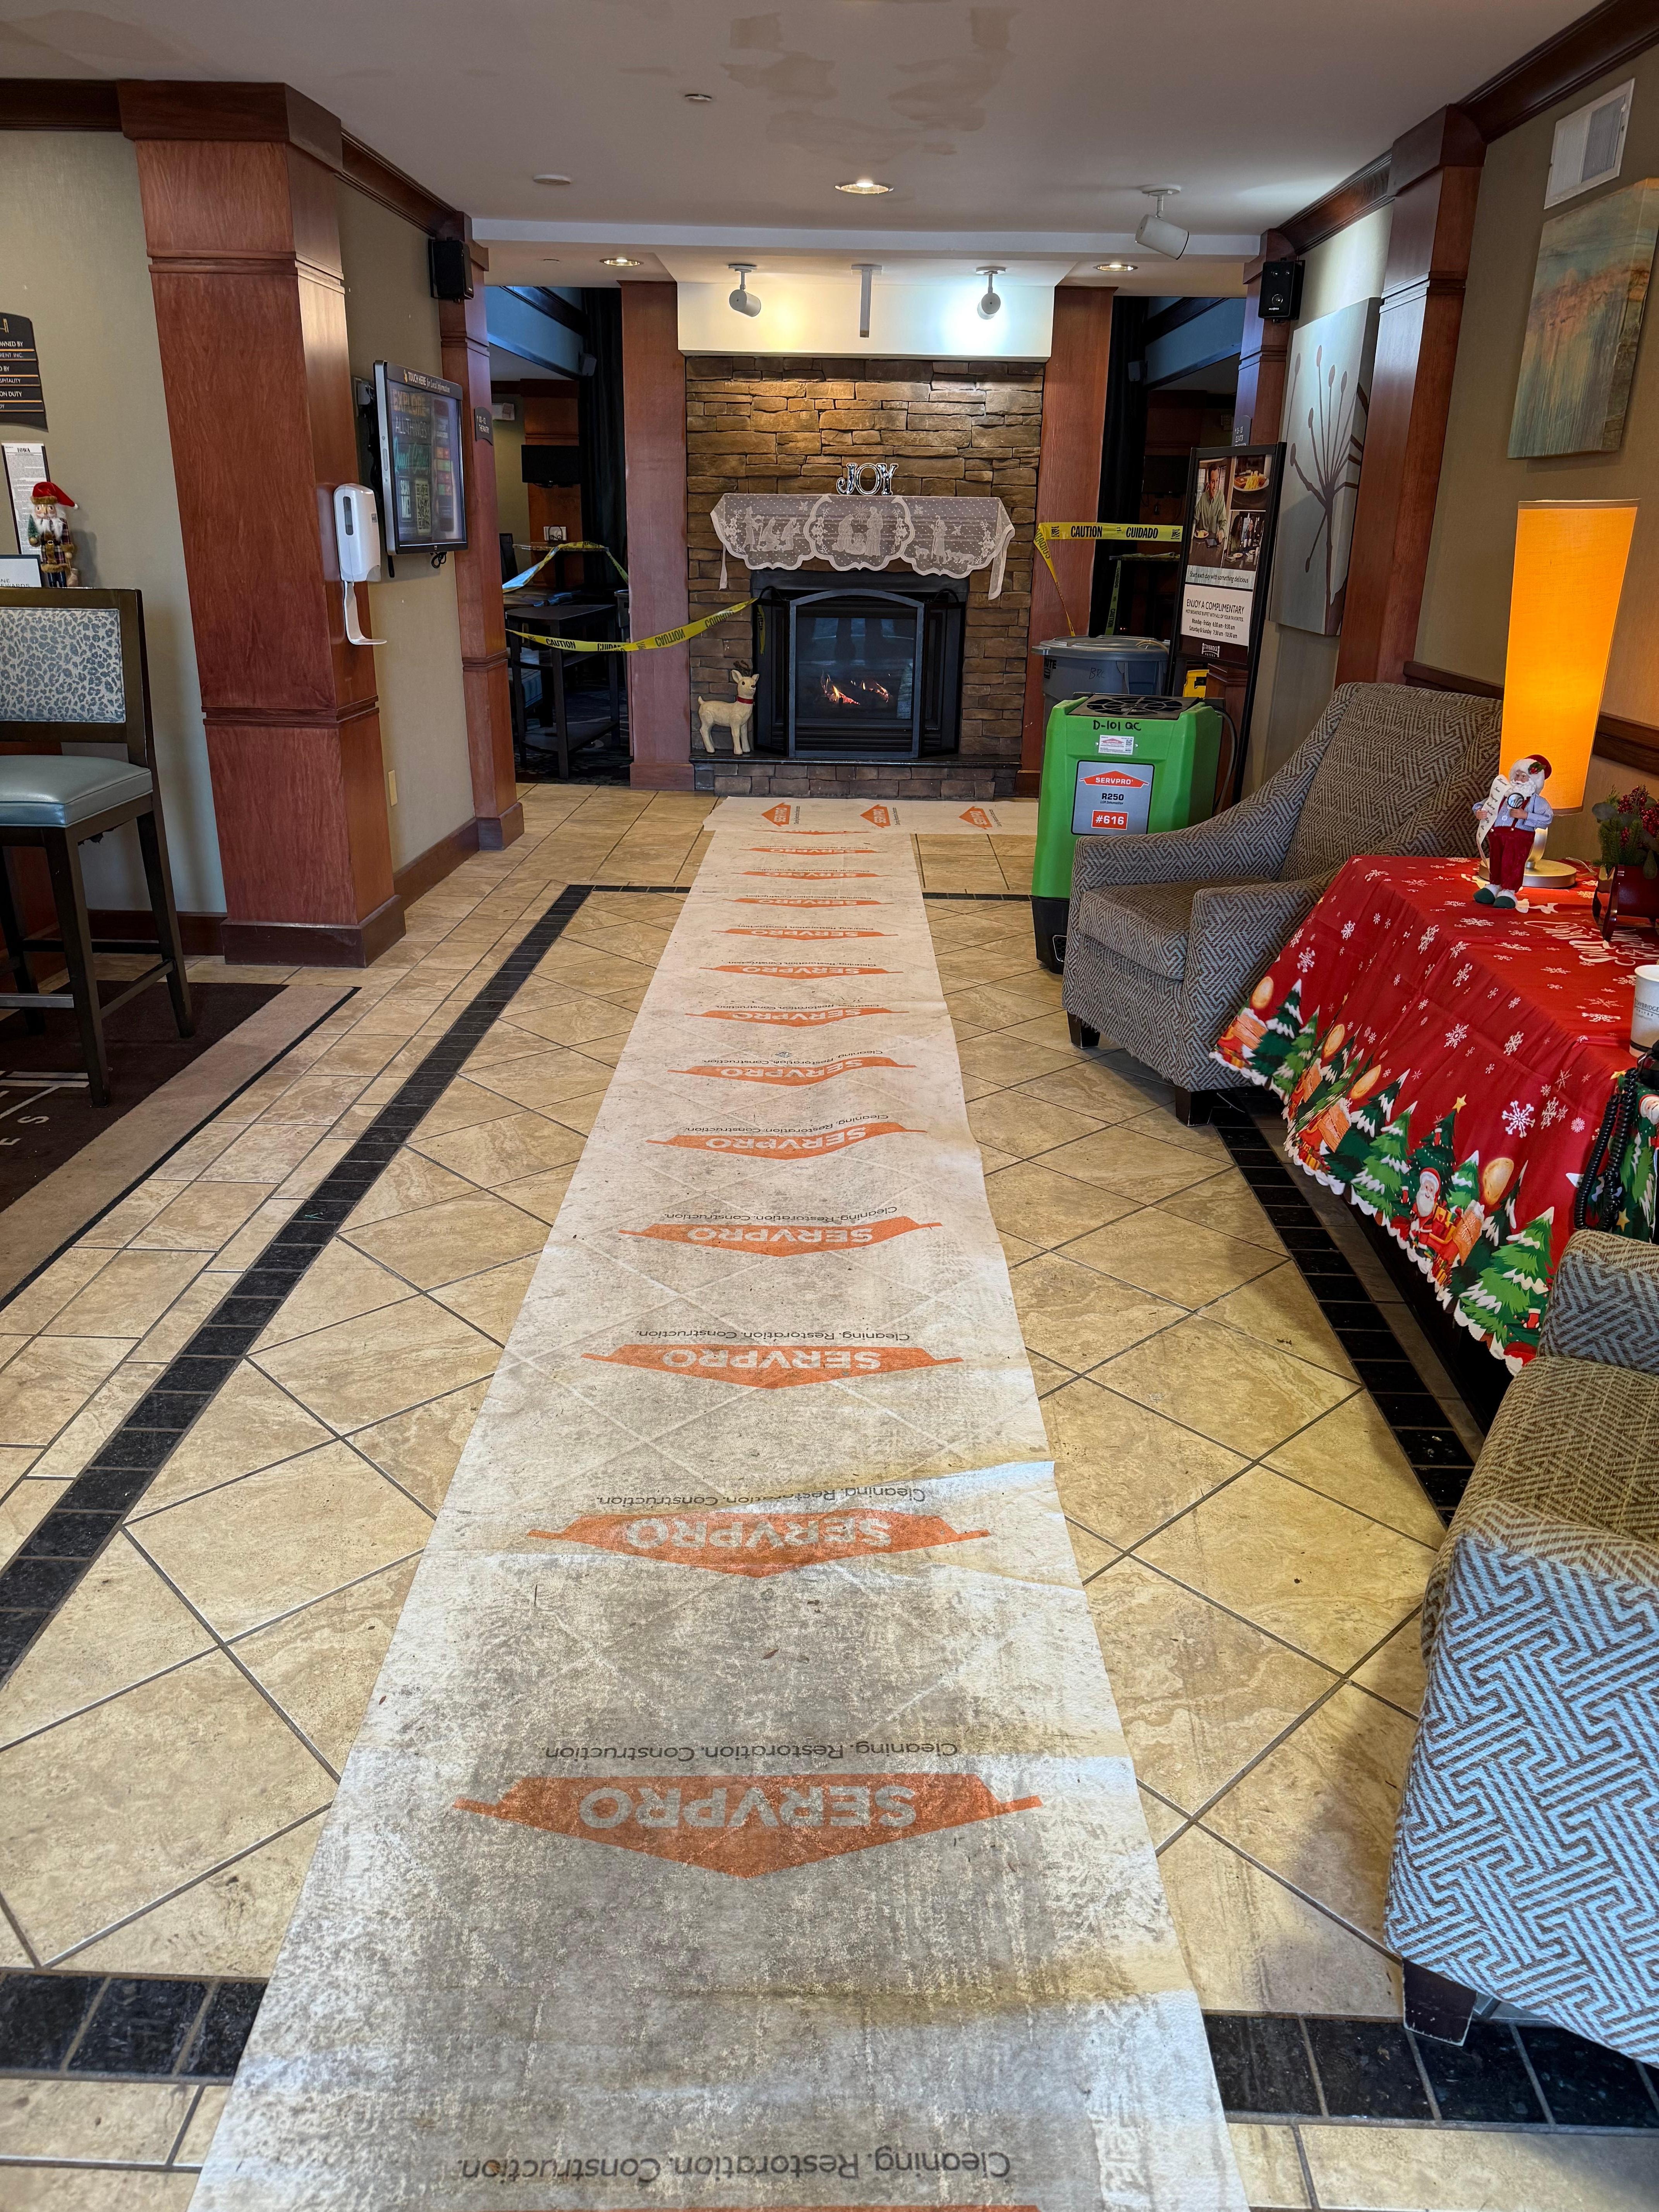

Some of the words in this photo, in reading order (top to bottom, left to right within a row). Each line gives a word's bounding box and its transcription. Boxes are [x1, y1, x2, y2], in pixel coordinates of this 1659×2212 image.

[408, 371, 419, 383] TOUCH
[395, 416, 406, 434] ALL
[836, 462, 899, 496] JOY
[1070, 526, 1103, 538] CAUTION
[1126, 527, 1158, 539] CUIDADO
[1218, 575, 1234, 583] something
[1187, 599, 1201, 608] ENJOY
[1206, 601, 1245, 615] COMPLIMENTARY
[546, 638, 576, 649] CAUTION
[1089, 668, 1105, 679] BRC
[1093, 720, 1120, 731] D-101
[1125, 721, 1142, 731] QC
[1096, 815, 1124, 825] #616
[732, 1009, 862, 1020] SERVPRO
[721, 1060, 862, 1077] SERVPRO
[706, 1127, 866, 1149] SERVPRO
[752, 1214, 833, 1223] Restoration.
[835, 1206, 897, 1221] Cleaning.
[687, 1228, 873, 1242] SERVPRO
[636, 1330, 736, 1340] Construction.
[739, 1330, 835, 1340] Restoration.
[839, 1331, 910, 1341] Cleaning.
[662, 1348, 881, 1370] SERVPRO
[597, 1495, 717, 1506] Construction.
[839, 1487, 926, 1503] Cleaning.
[626, 1517, 891, 1549] SERVPRO
[543, 1747, 693, 1761] Construction.
[702, 1744, 843, 1759] Restoration.
[850, 1743, 958, 1758] Cleaning.
[581, 1785, 916, 1829] SERVPRO
[667, 2152, 858, 2181] Restoration.
[867, 2145, 1010, 2180] Cleaning.
[457, 2158, 661, 2183] Construction.
